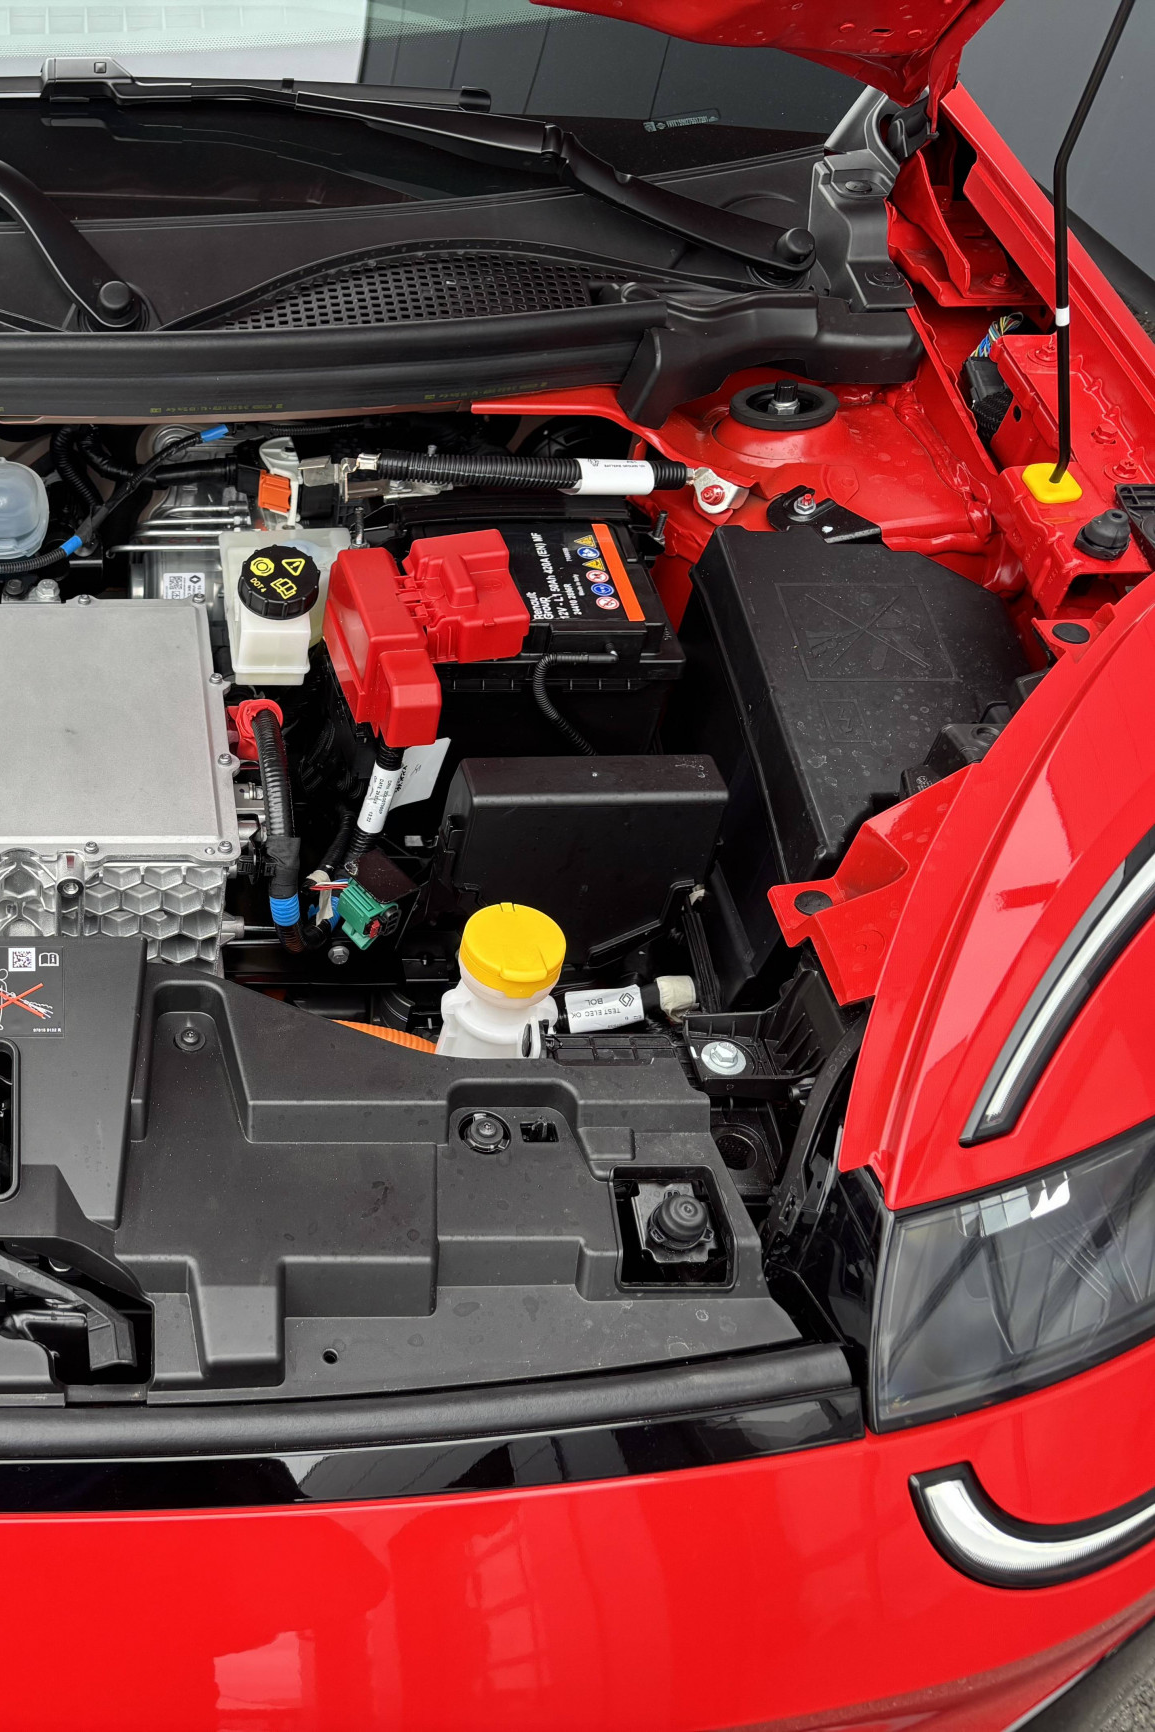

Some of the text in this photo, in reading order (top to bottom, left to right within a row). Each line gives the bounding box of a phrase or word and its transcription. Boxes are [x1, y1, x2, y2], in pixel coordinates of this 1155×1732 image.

[540, 558, 553, 574] 420A
[250, 578, 264, 588] DOT
[526, 592, 544, 620] Renault
[539, 597, 553, 619] Group
[556, 607, 569, 619] 12V
[584, 998, 603, 1006] BOL
